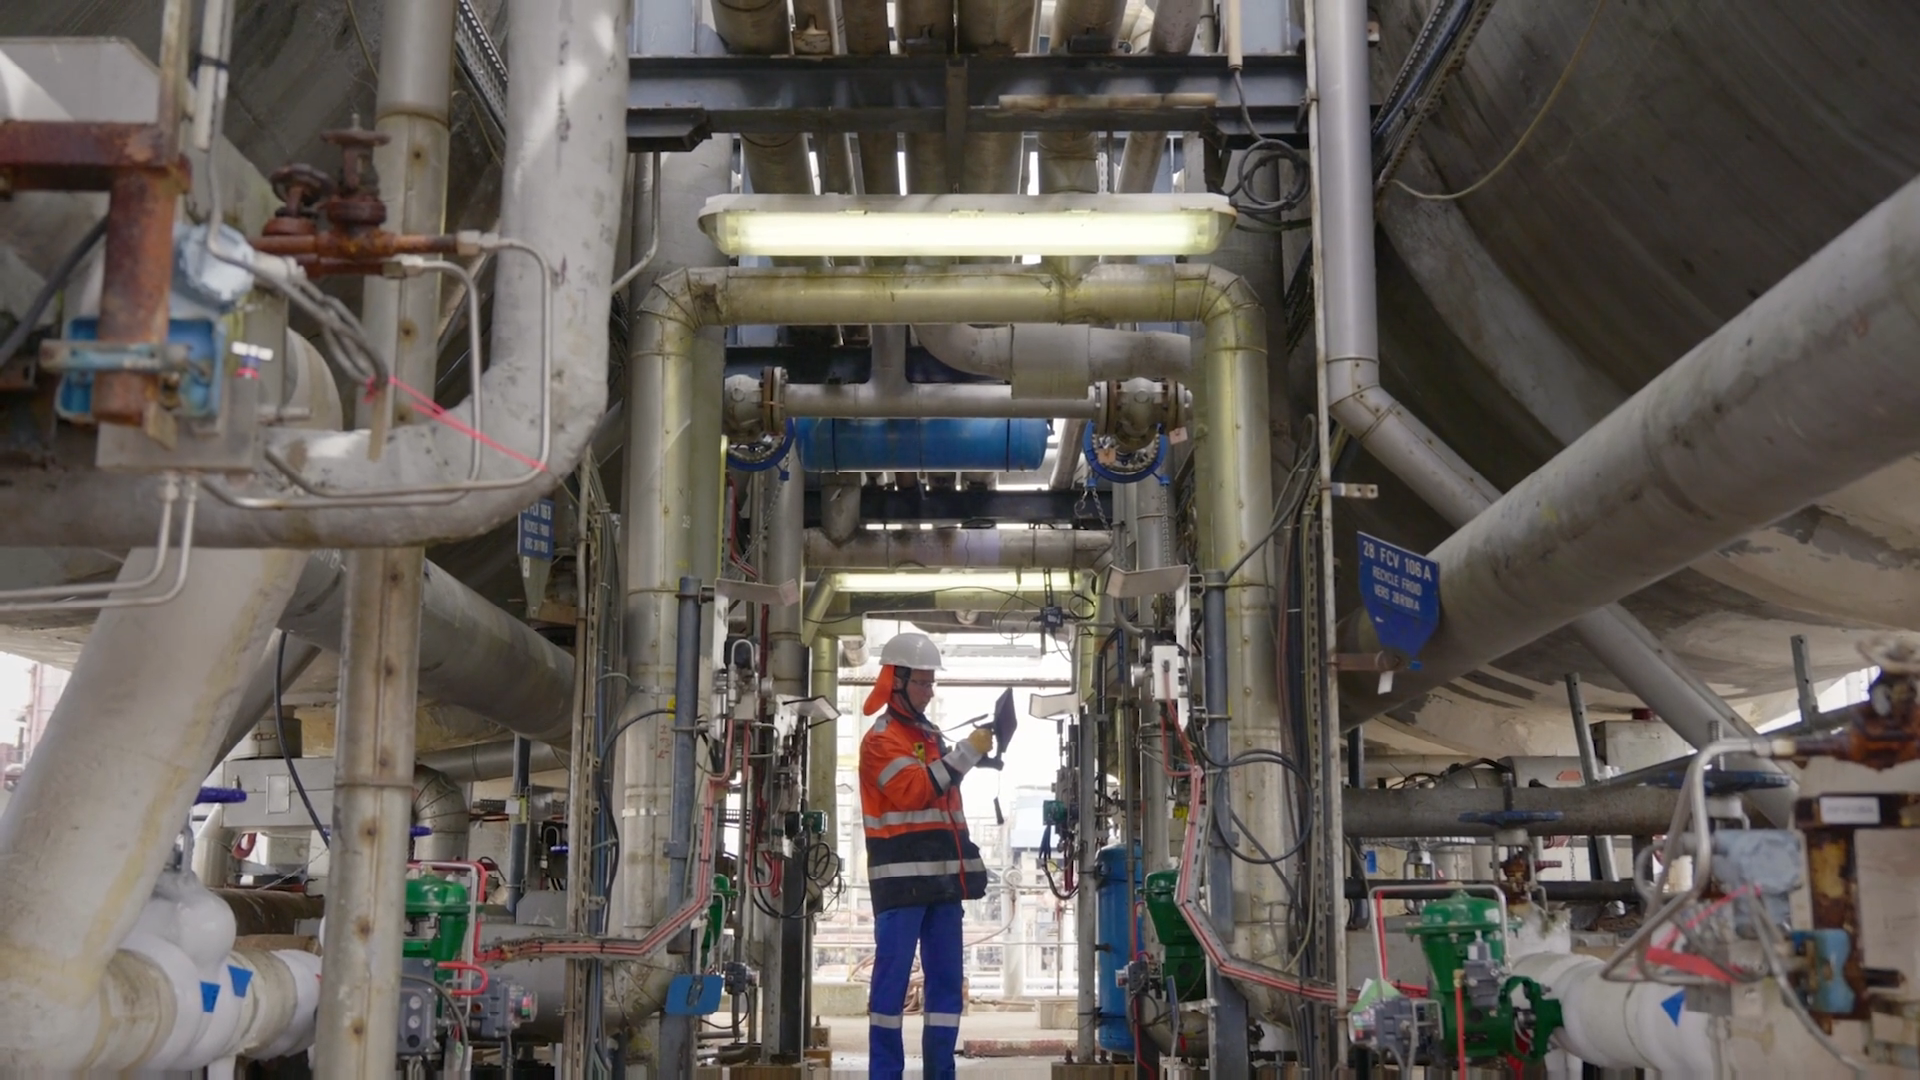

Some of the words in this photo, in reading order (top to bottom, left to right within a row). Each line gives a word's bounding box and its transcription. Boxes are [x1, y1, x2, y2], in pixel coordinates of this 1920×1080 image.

[1363, 540, 1375, 559] 28
[1380, 547, 1400, 569] FCV
[1401, 577, 1422, 597] FROID
